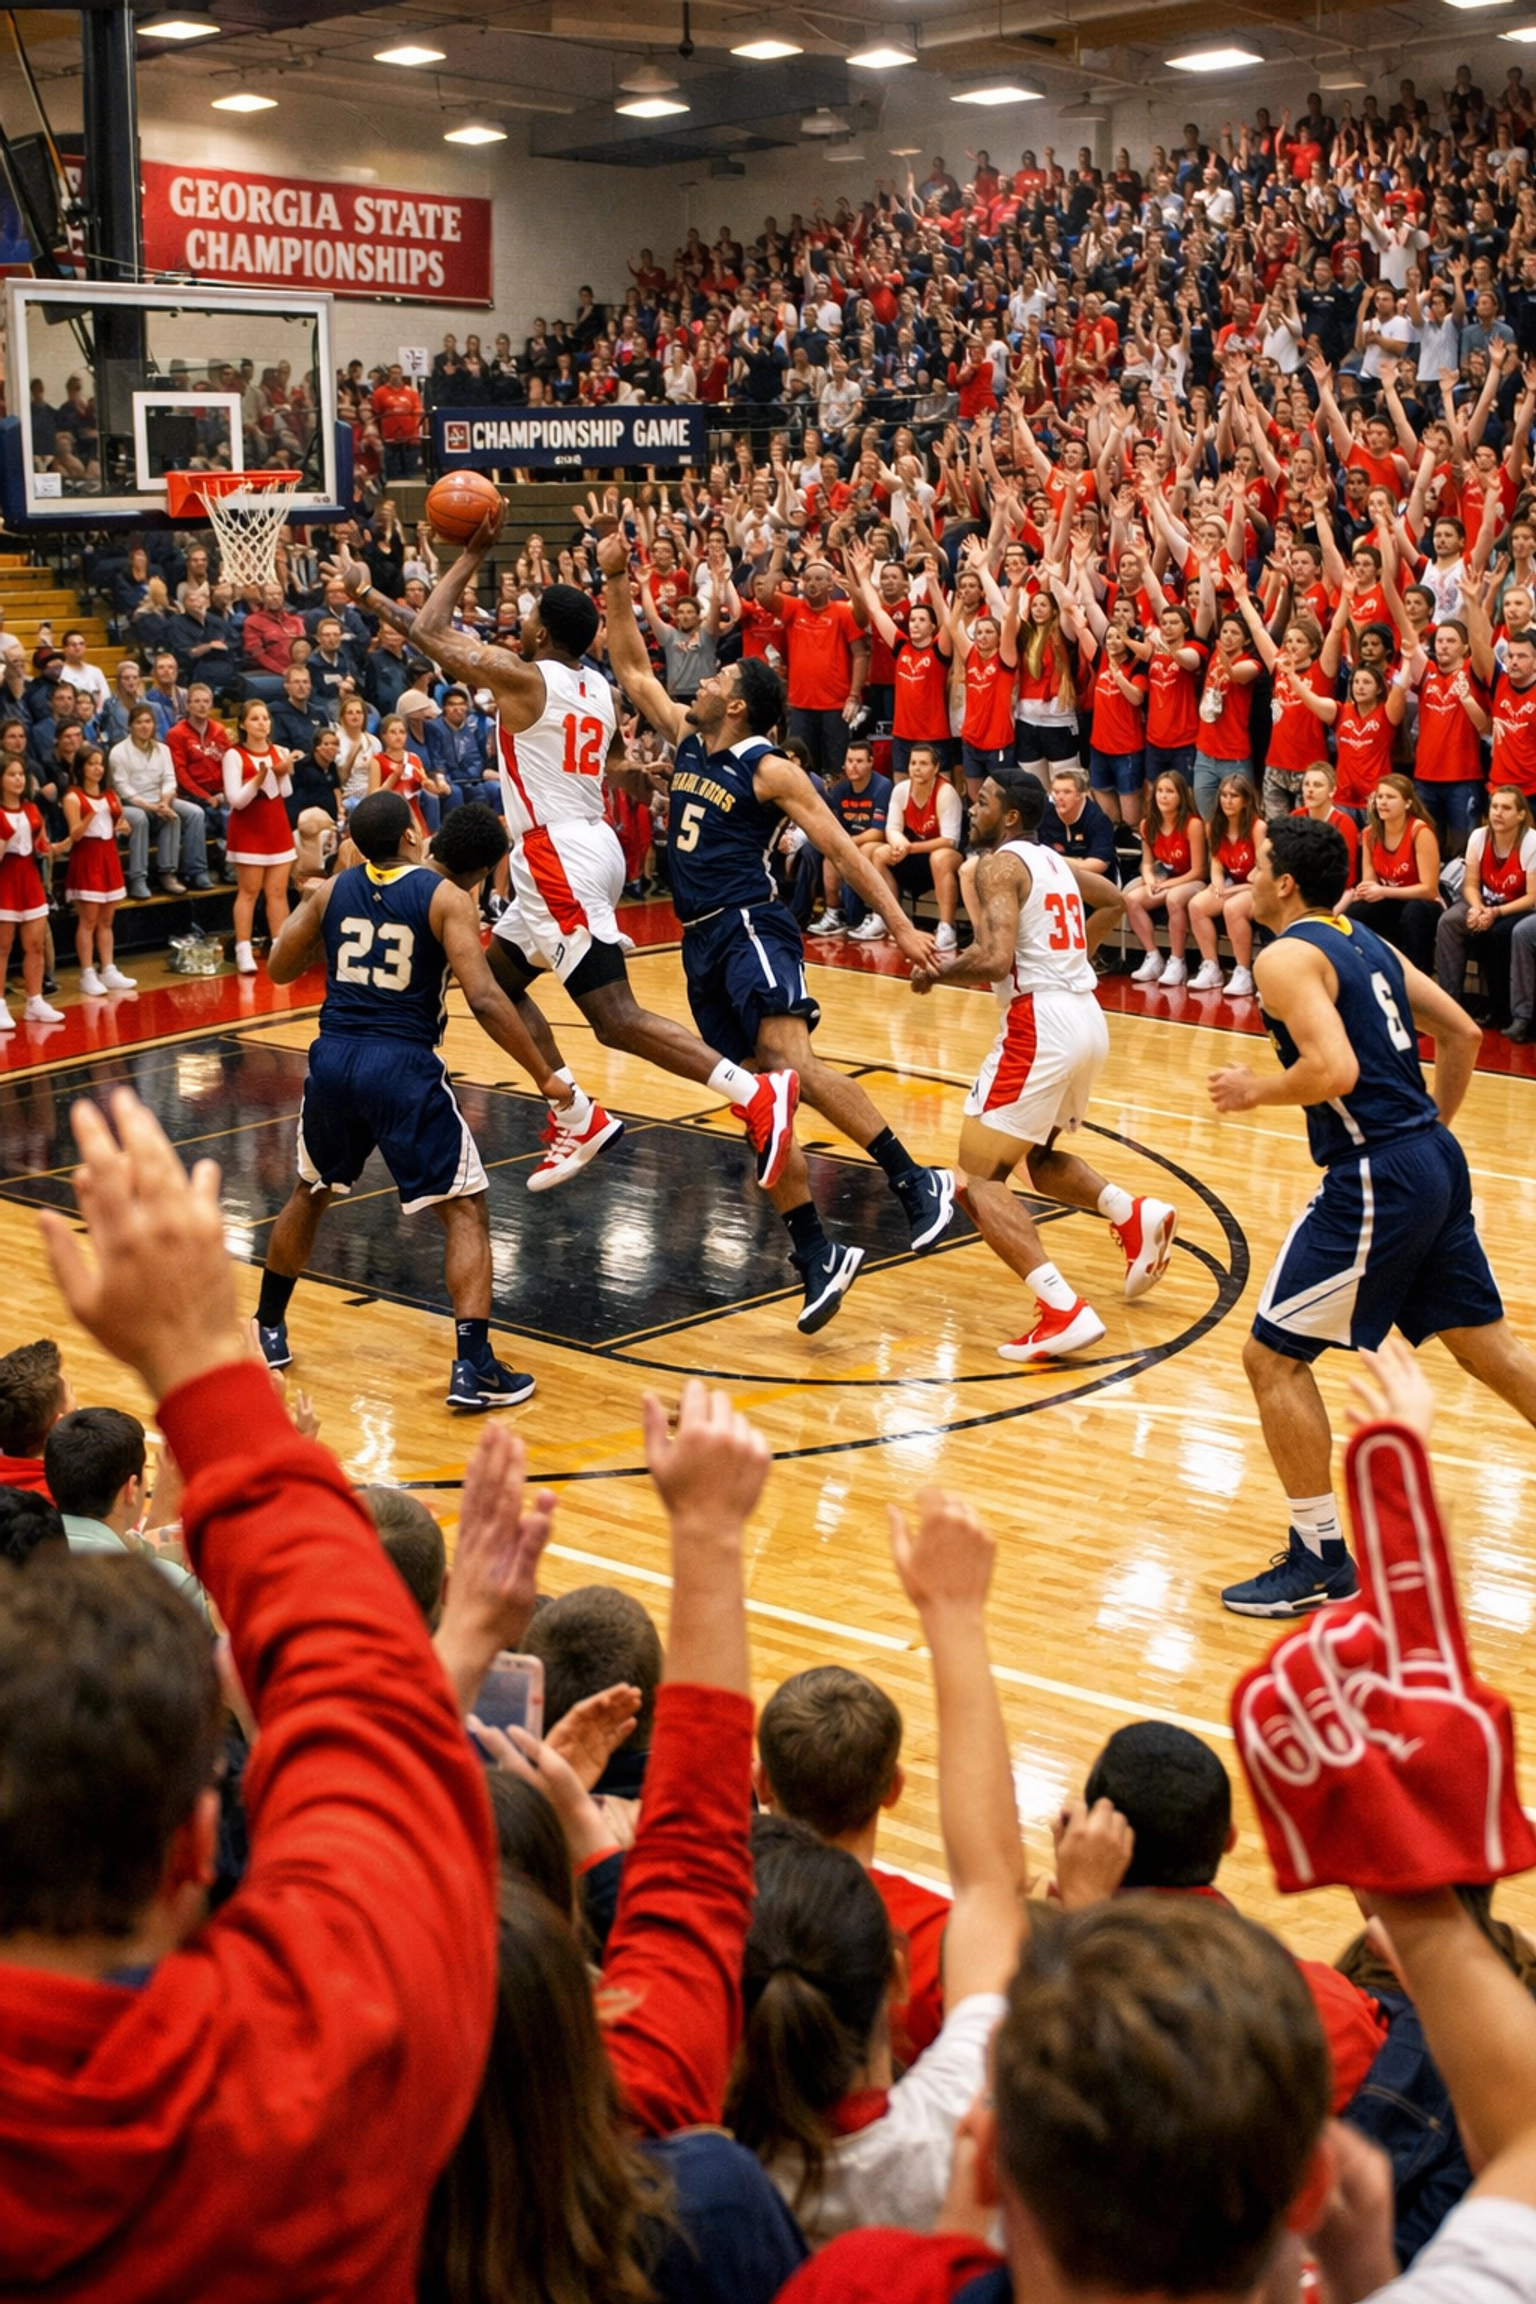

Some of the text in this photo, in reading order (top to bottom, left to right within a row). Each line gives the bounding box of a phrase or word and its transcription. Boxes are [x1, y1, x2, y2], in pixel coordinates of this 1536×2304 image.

[169, 176, 462, 242] GEORGIA STATE
[185, 228, 446, 288] CHAMPIONSHIPS
[472, 419, 625, 450] CHAMPIONSHIP
[633, 419, 691, 447] GAME
[562, 712, 604, 777] 12
[676, 802, 706, 852] 5
[1044, 893, 1086, 950] 33
[335, 915, 415, 992] 23
